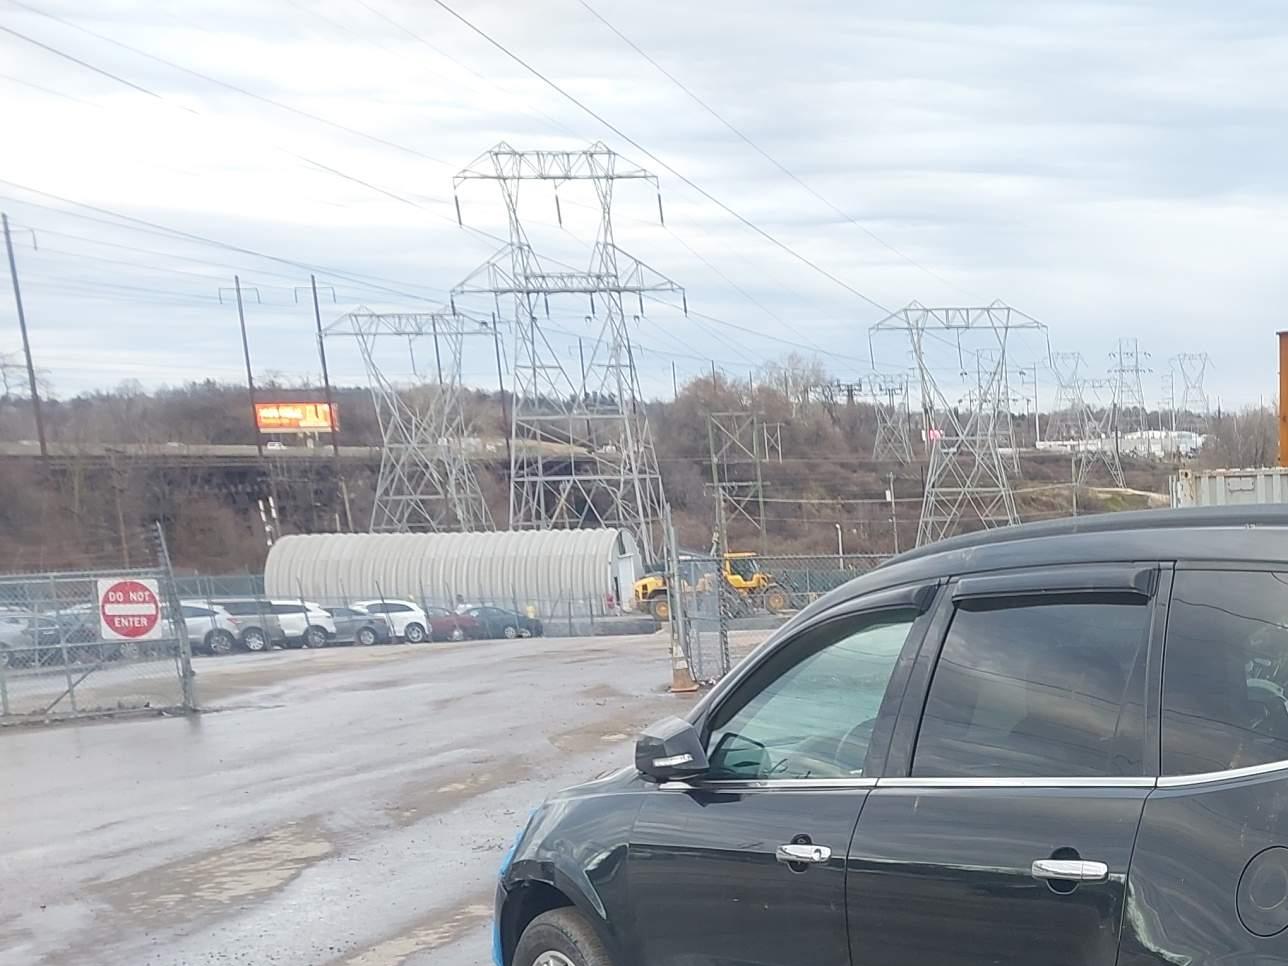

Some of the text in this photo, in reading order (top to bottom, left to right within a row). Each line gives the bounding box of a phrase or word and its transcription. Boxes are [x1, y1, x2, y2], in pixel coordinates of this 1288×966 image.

[108, 591, 150, 602] DO NOT
[114, 617, 148, 628] ENTER
